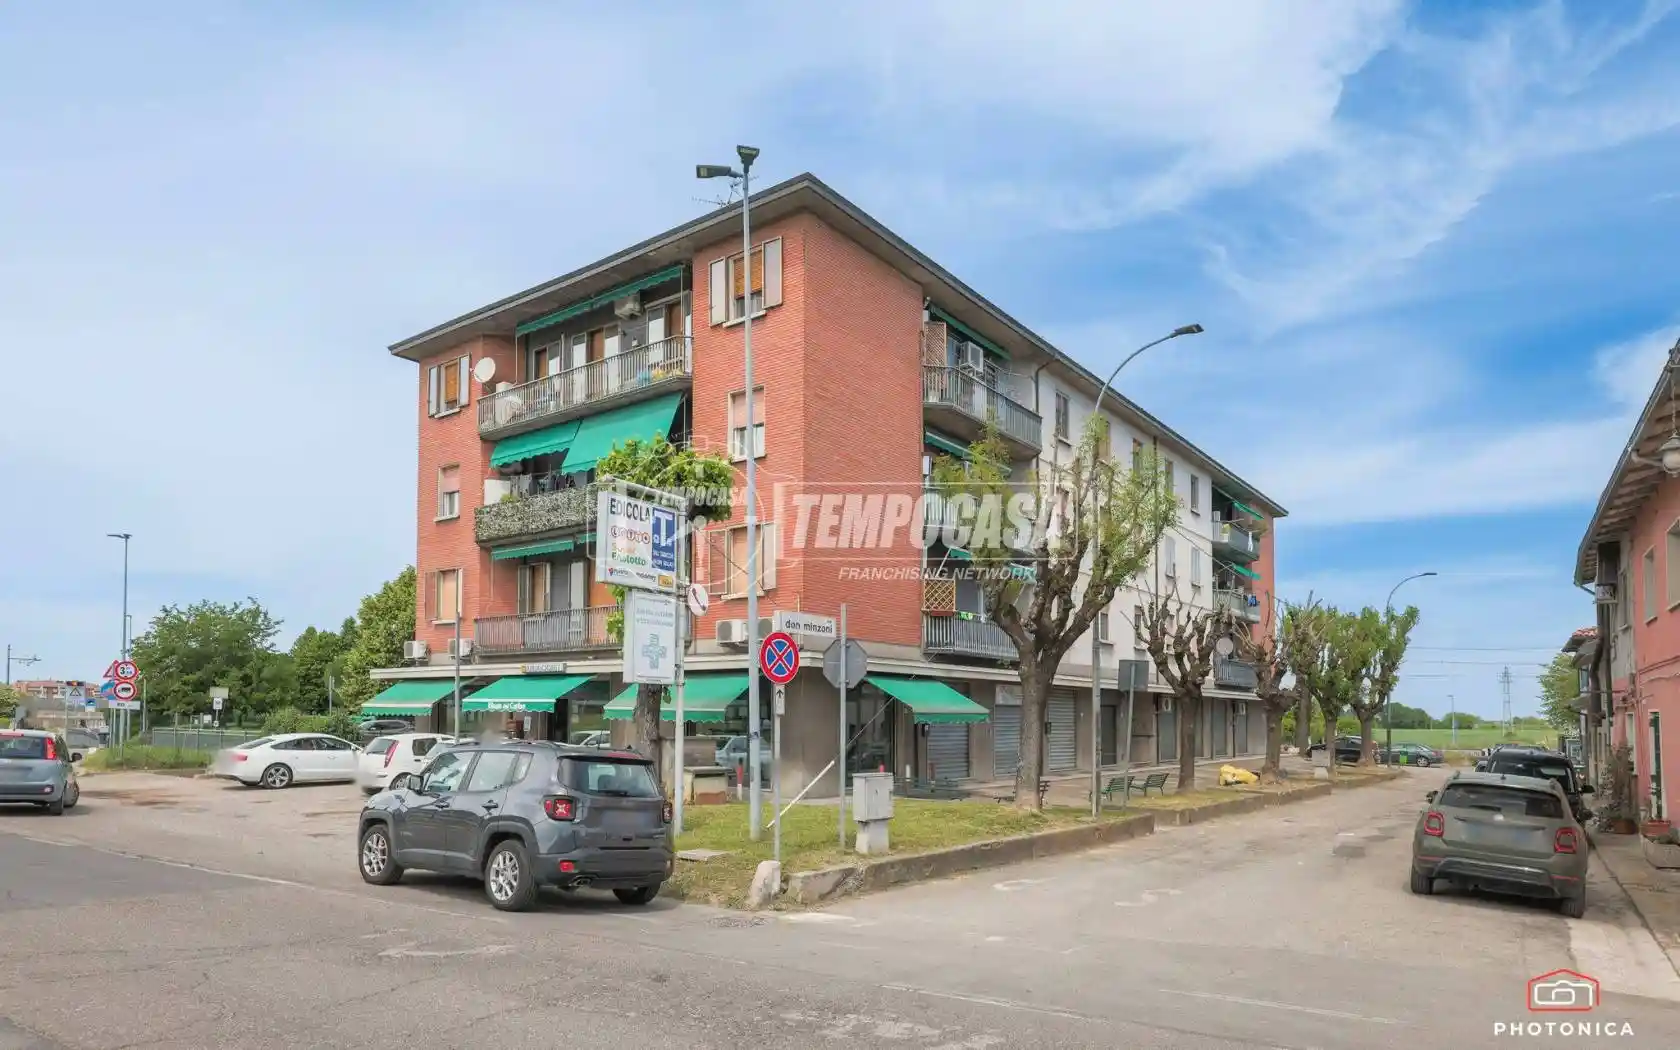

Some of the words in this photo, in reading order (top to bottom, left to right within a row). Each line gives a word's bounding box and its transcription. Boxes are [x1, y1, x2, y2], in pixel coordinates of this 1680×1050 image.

[610, 497, 650, 522] EDICOLA
[785, 619, 800, 630] don
[803, 622, 833, 633] minzoni
